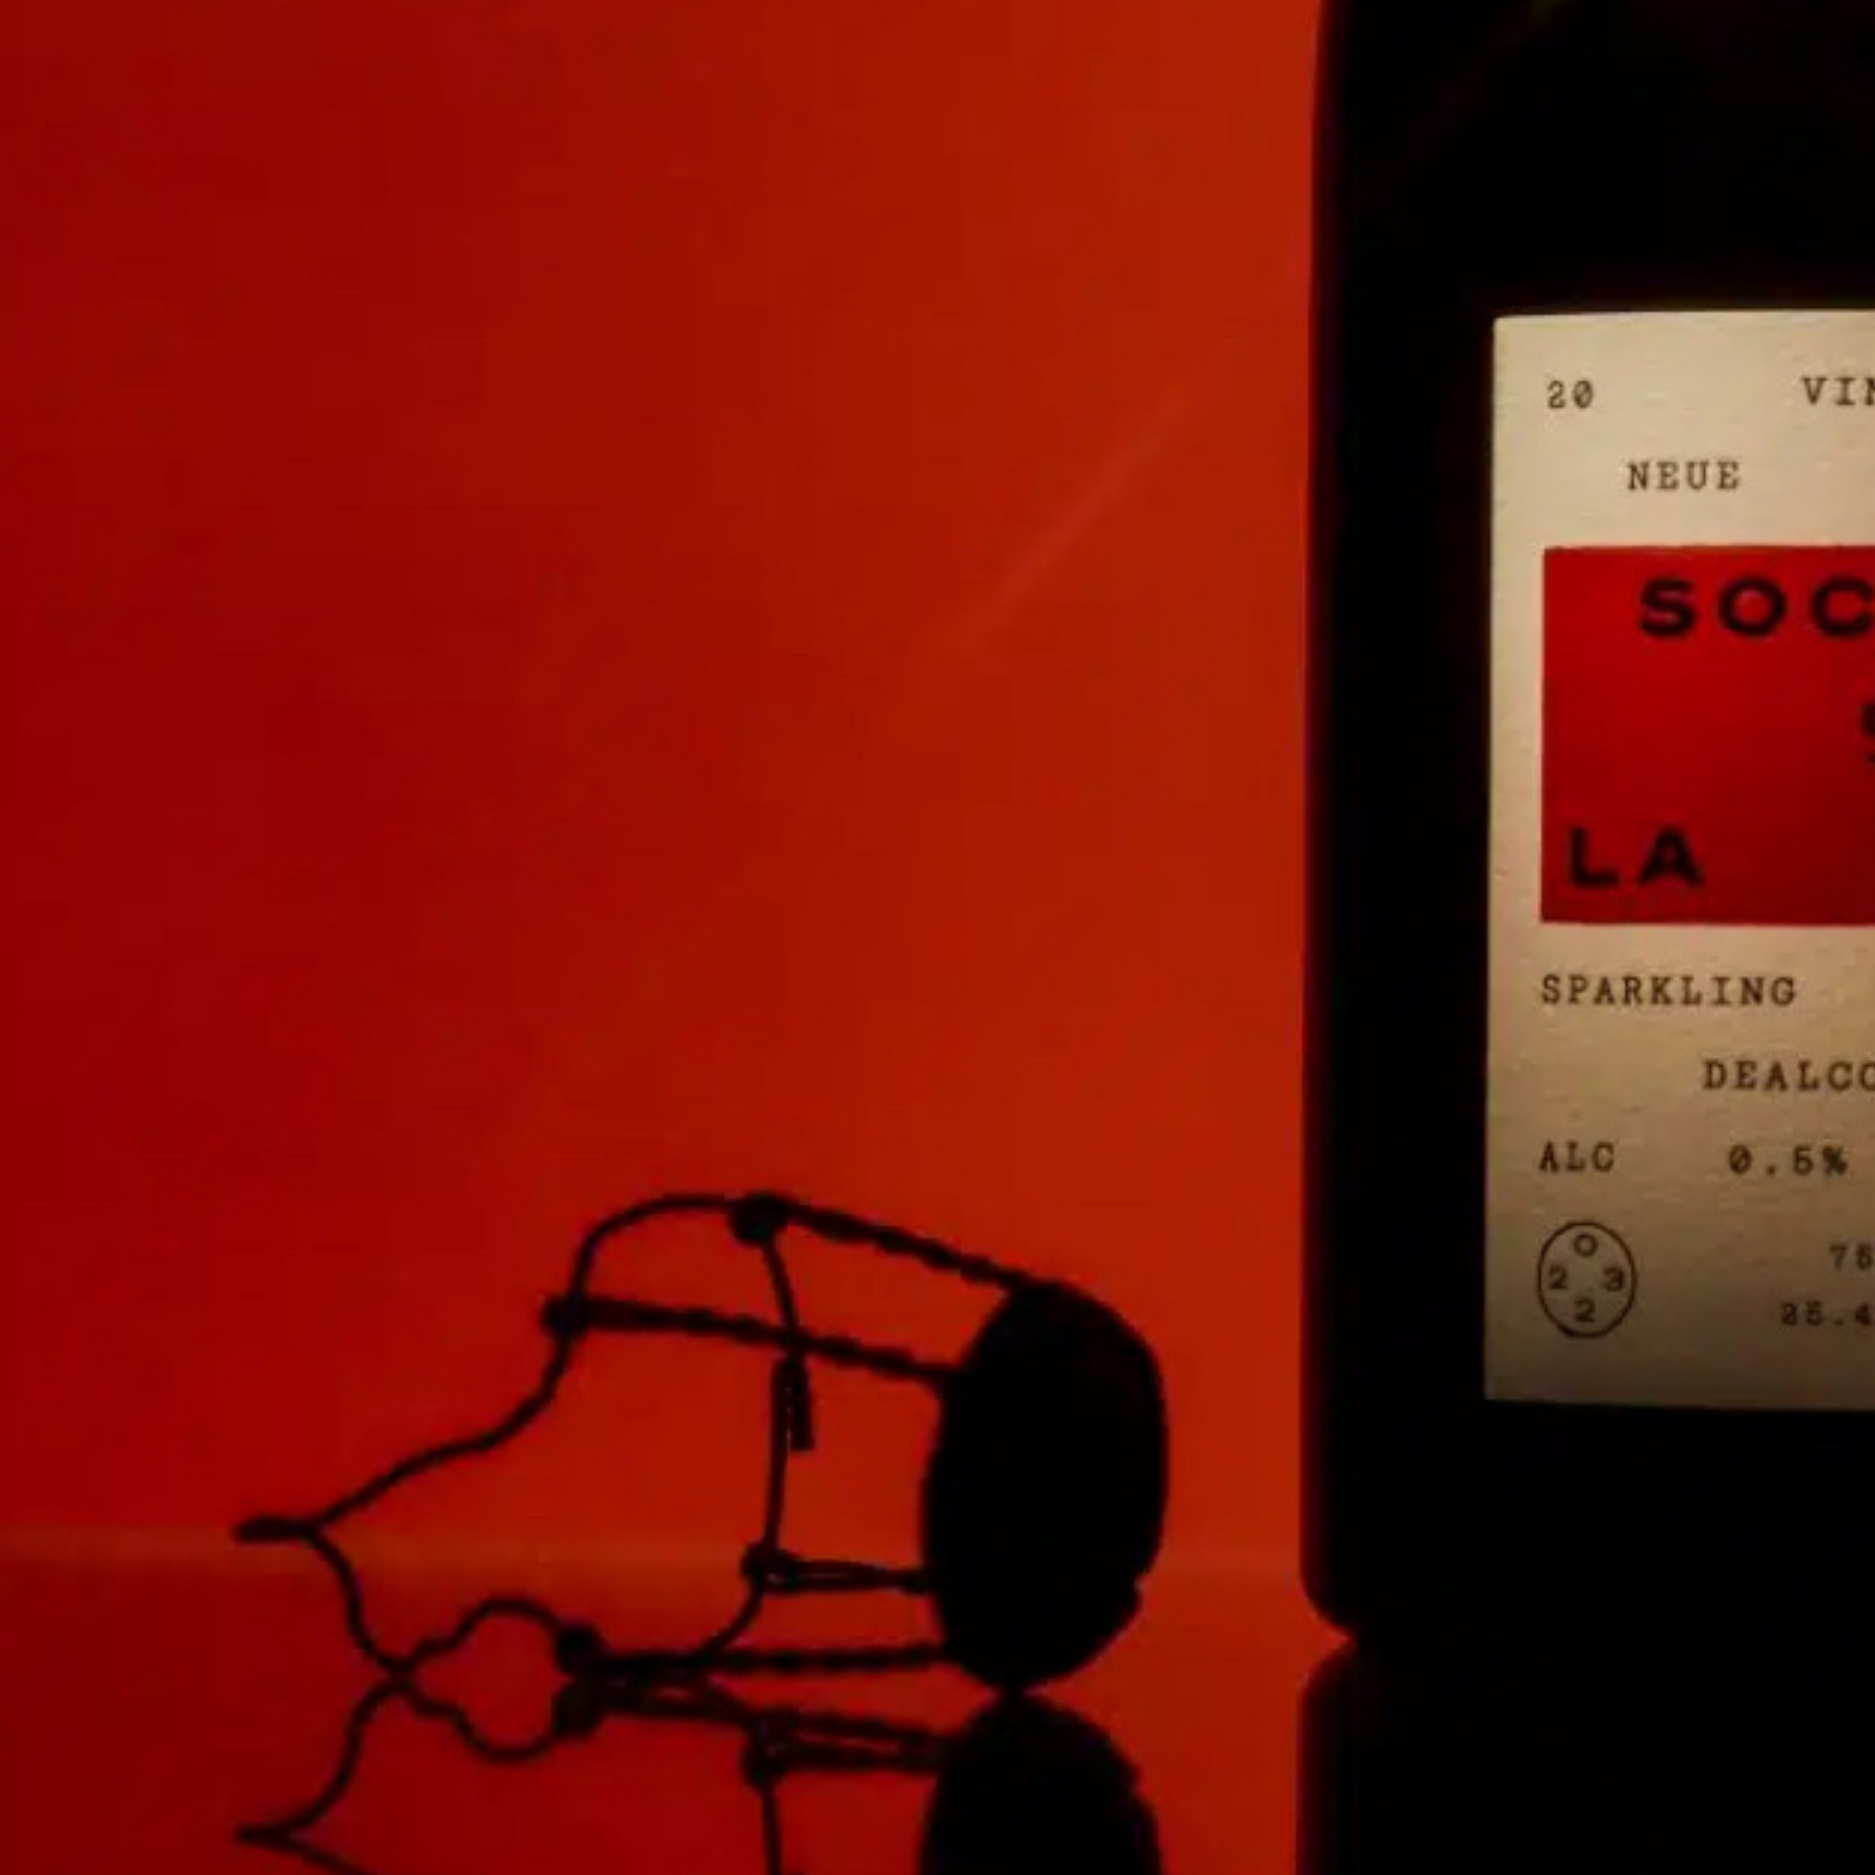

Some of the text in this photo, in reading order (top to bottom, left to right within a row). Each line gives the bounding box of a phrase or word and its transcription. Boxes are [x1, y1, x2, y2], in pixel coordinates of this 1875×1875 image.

[1547, 379, 1594, 410] 20
[1627, 461, 1742, 492] NEUE
[1564, 827, 1704, 889] LA
[1541, 975, 1798, 1008] SPARKLING
[1539, 1142, 1616, 1173] ALC
[1728, 1144, 1849, 1177] 0.5%
